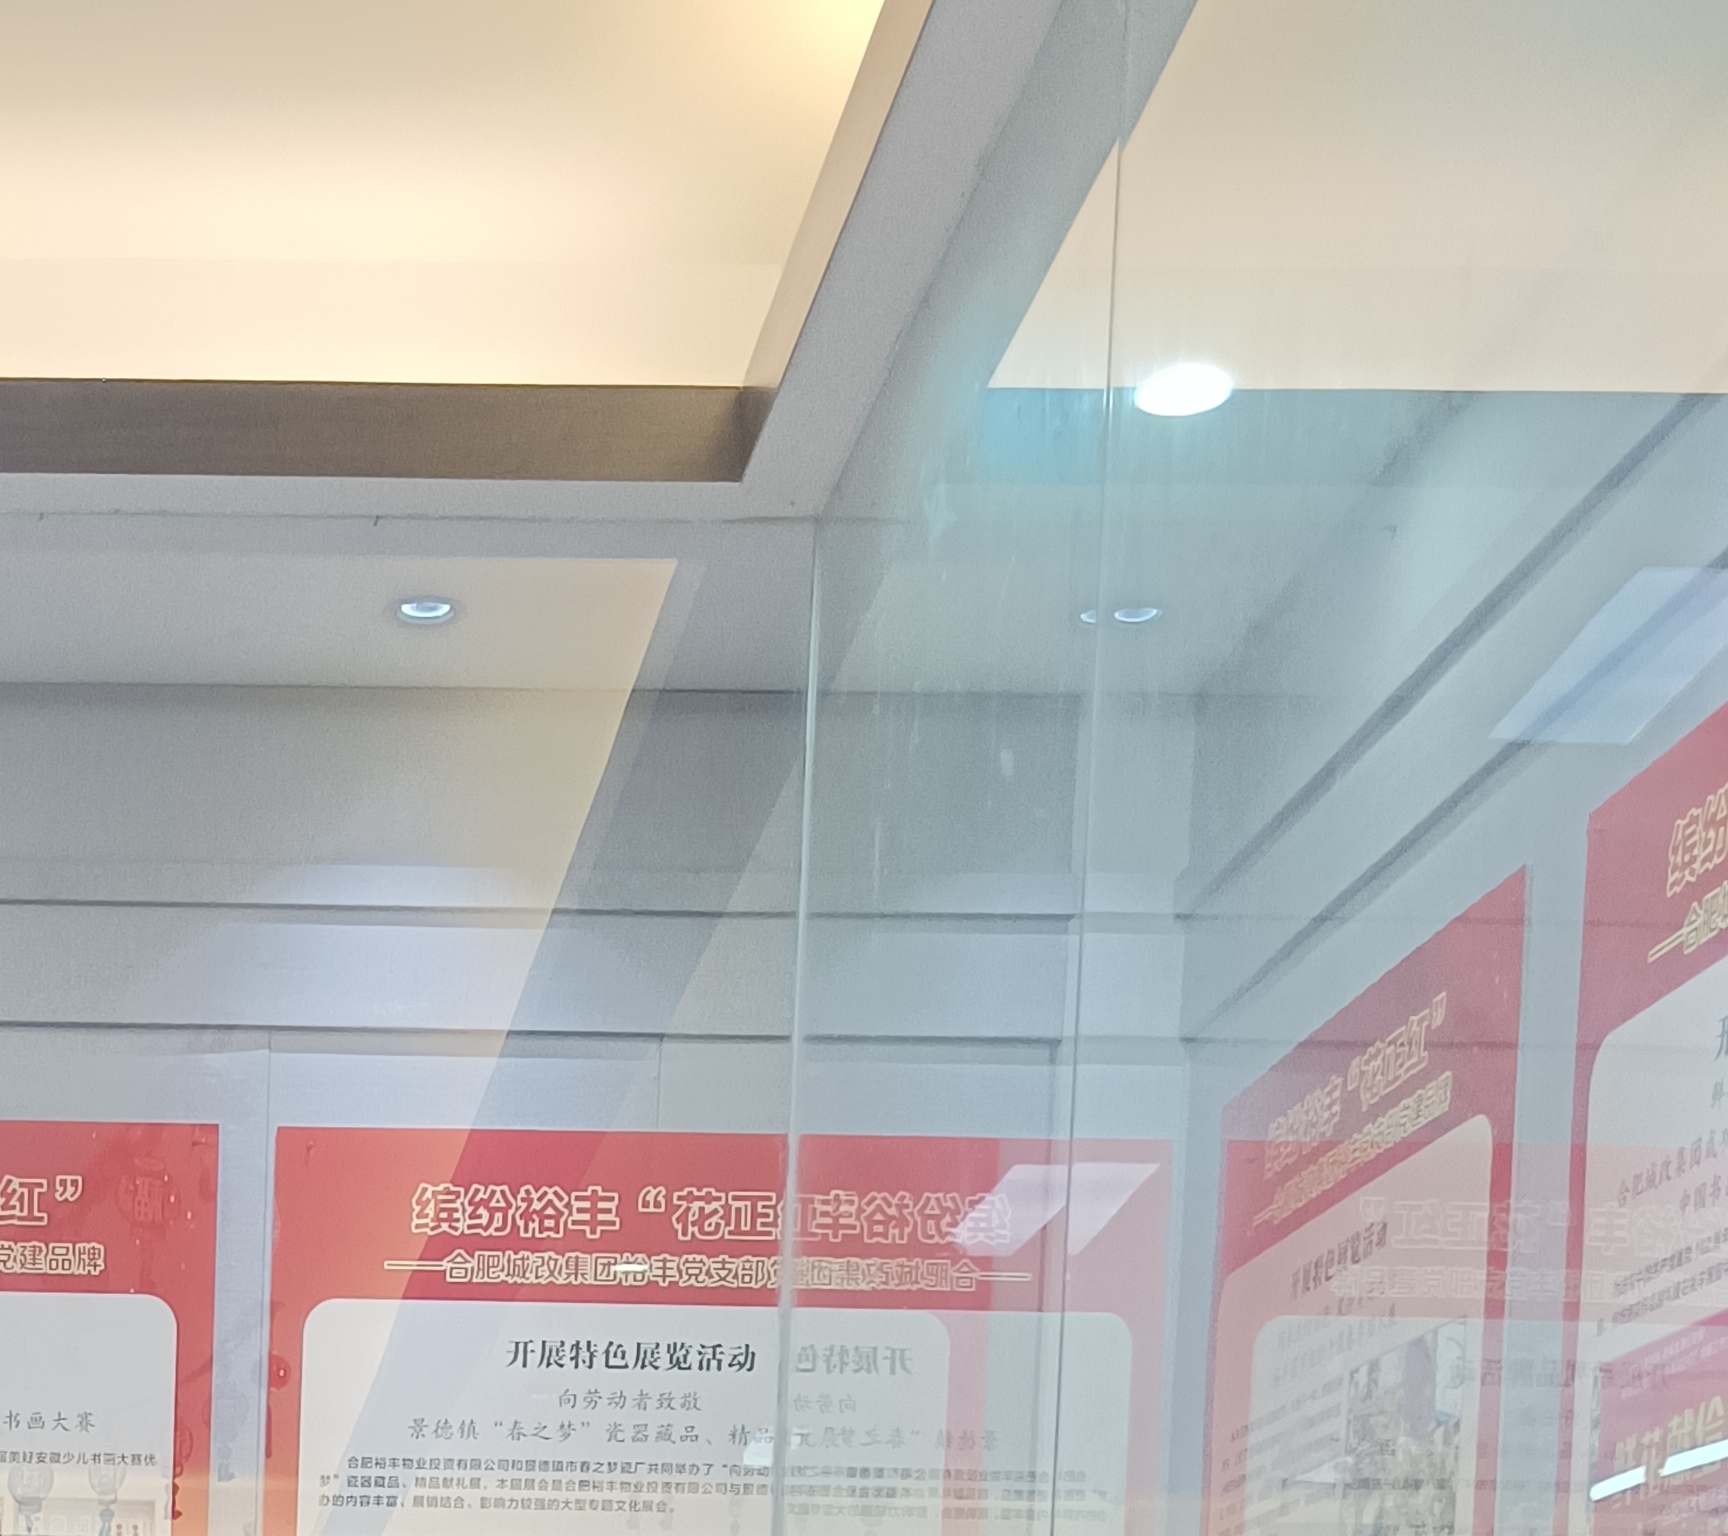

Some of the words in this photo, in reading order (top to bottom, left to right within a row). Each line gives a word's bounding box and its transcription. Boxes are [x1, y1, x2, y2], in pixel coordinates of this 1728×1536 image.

[505, 1338, 757, 1375] 开展特色展览活动
[558, 1387, 703, 1413] 向劳动者致敬
